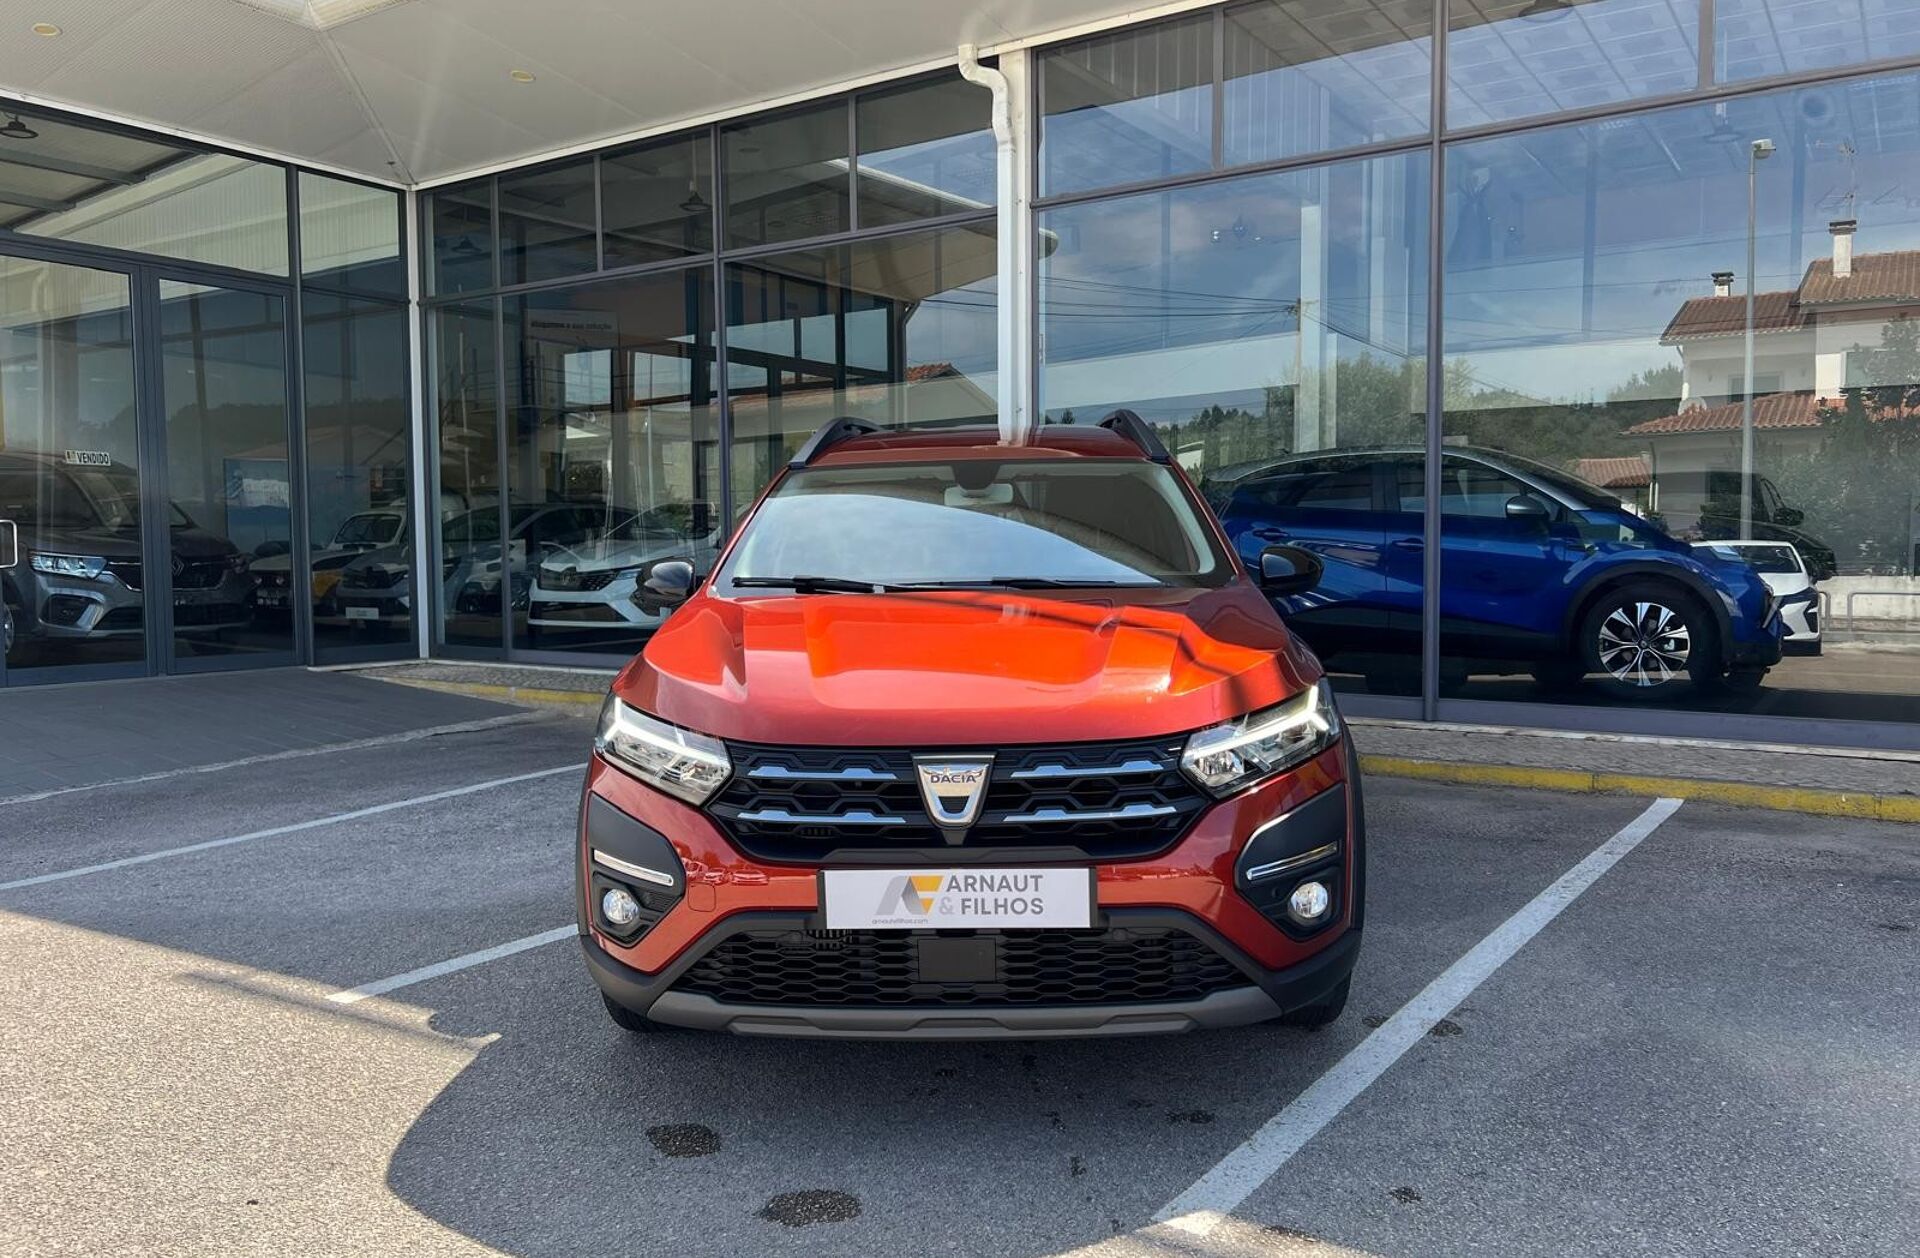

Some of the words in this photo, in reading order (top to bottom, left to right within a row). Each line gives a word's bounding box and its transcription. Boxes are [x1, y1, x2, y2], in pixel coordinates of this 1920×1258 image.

[76, 452, 109, 465] VENDIDO
[930, 774, 976, 784] DACIA
[946, 874, 1043, 893] ARNAUT
[938, 896, 955, 916] &
[961, 897, 1044, 915] FILHOS
